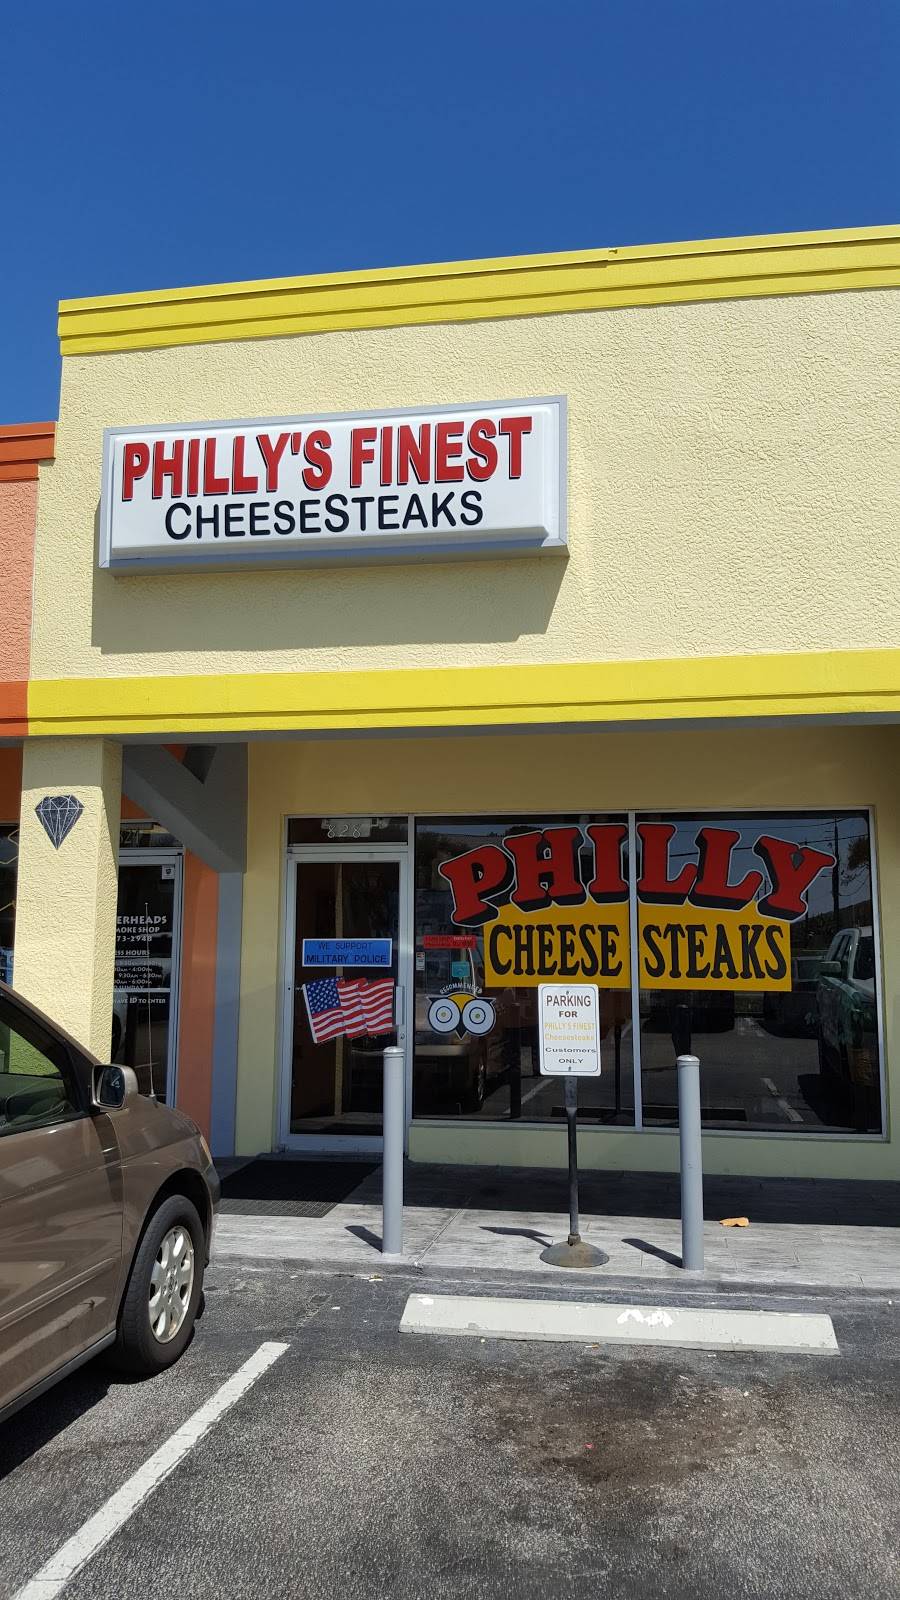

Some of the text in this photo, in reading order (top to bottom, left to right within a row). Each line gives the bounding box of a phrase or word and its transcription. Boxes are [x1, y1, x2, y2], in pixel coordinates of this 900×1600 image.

[122, 416, 533, 501] PHILLY'S FINEST
[165, 491, 484, 540] CHEESESTEAKS
[438, 822, 838, 927] PHILLY
[319, 942, 373, 950] WE SUPPORT
[489, 923, 787, 981] CHEESE STEAKS
[306, 954, 387, 963] MILITARY POLICE
[546, 995, 592, 1007] PARKING
[559, 1010, 578, 1018] FOR
[544, 1022, 596, 1031] PHILLY'S FINEST
